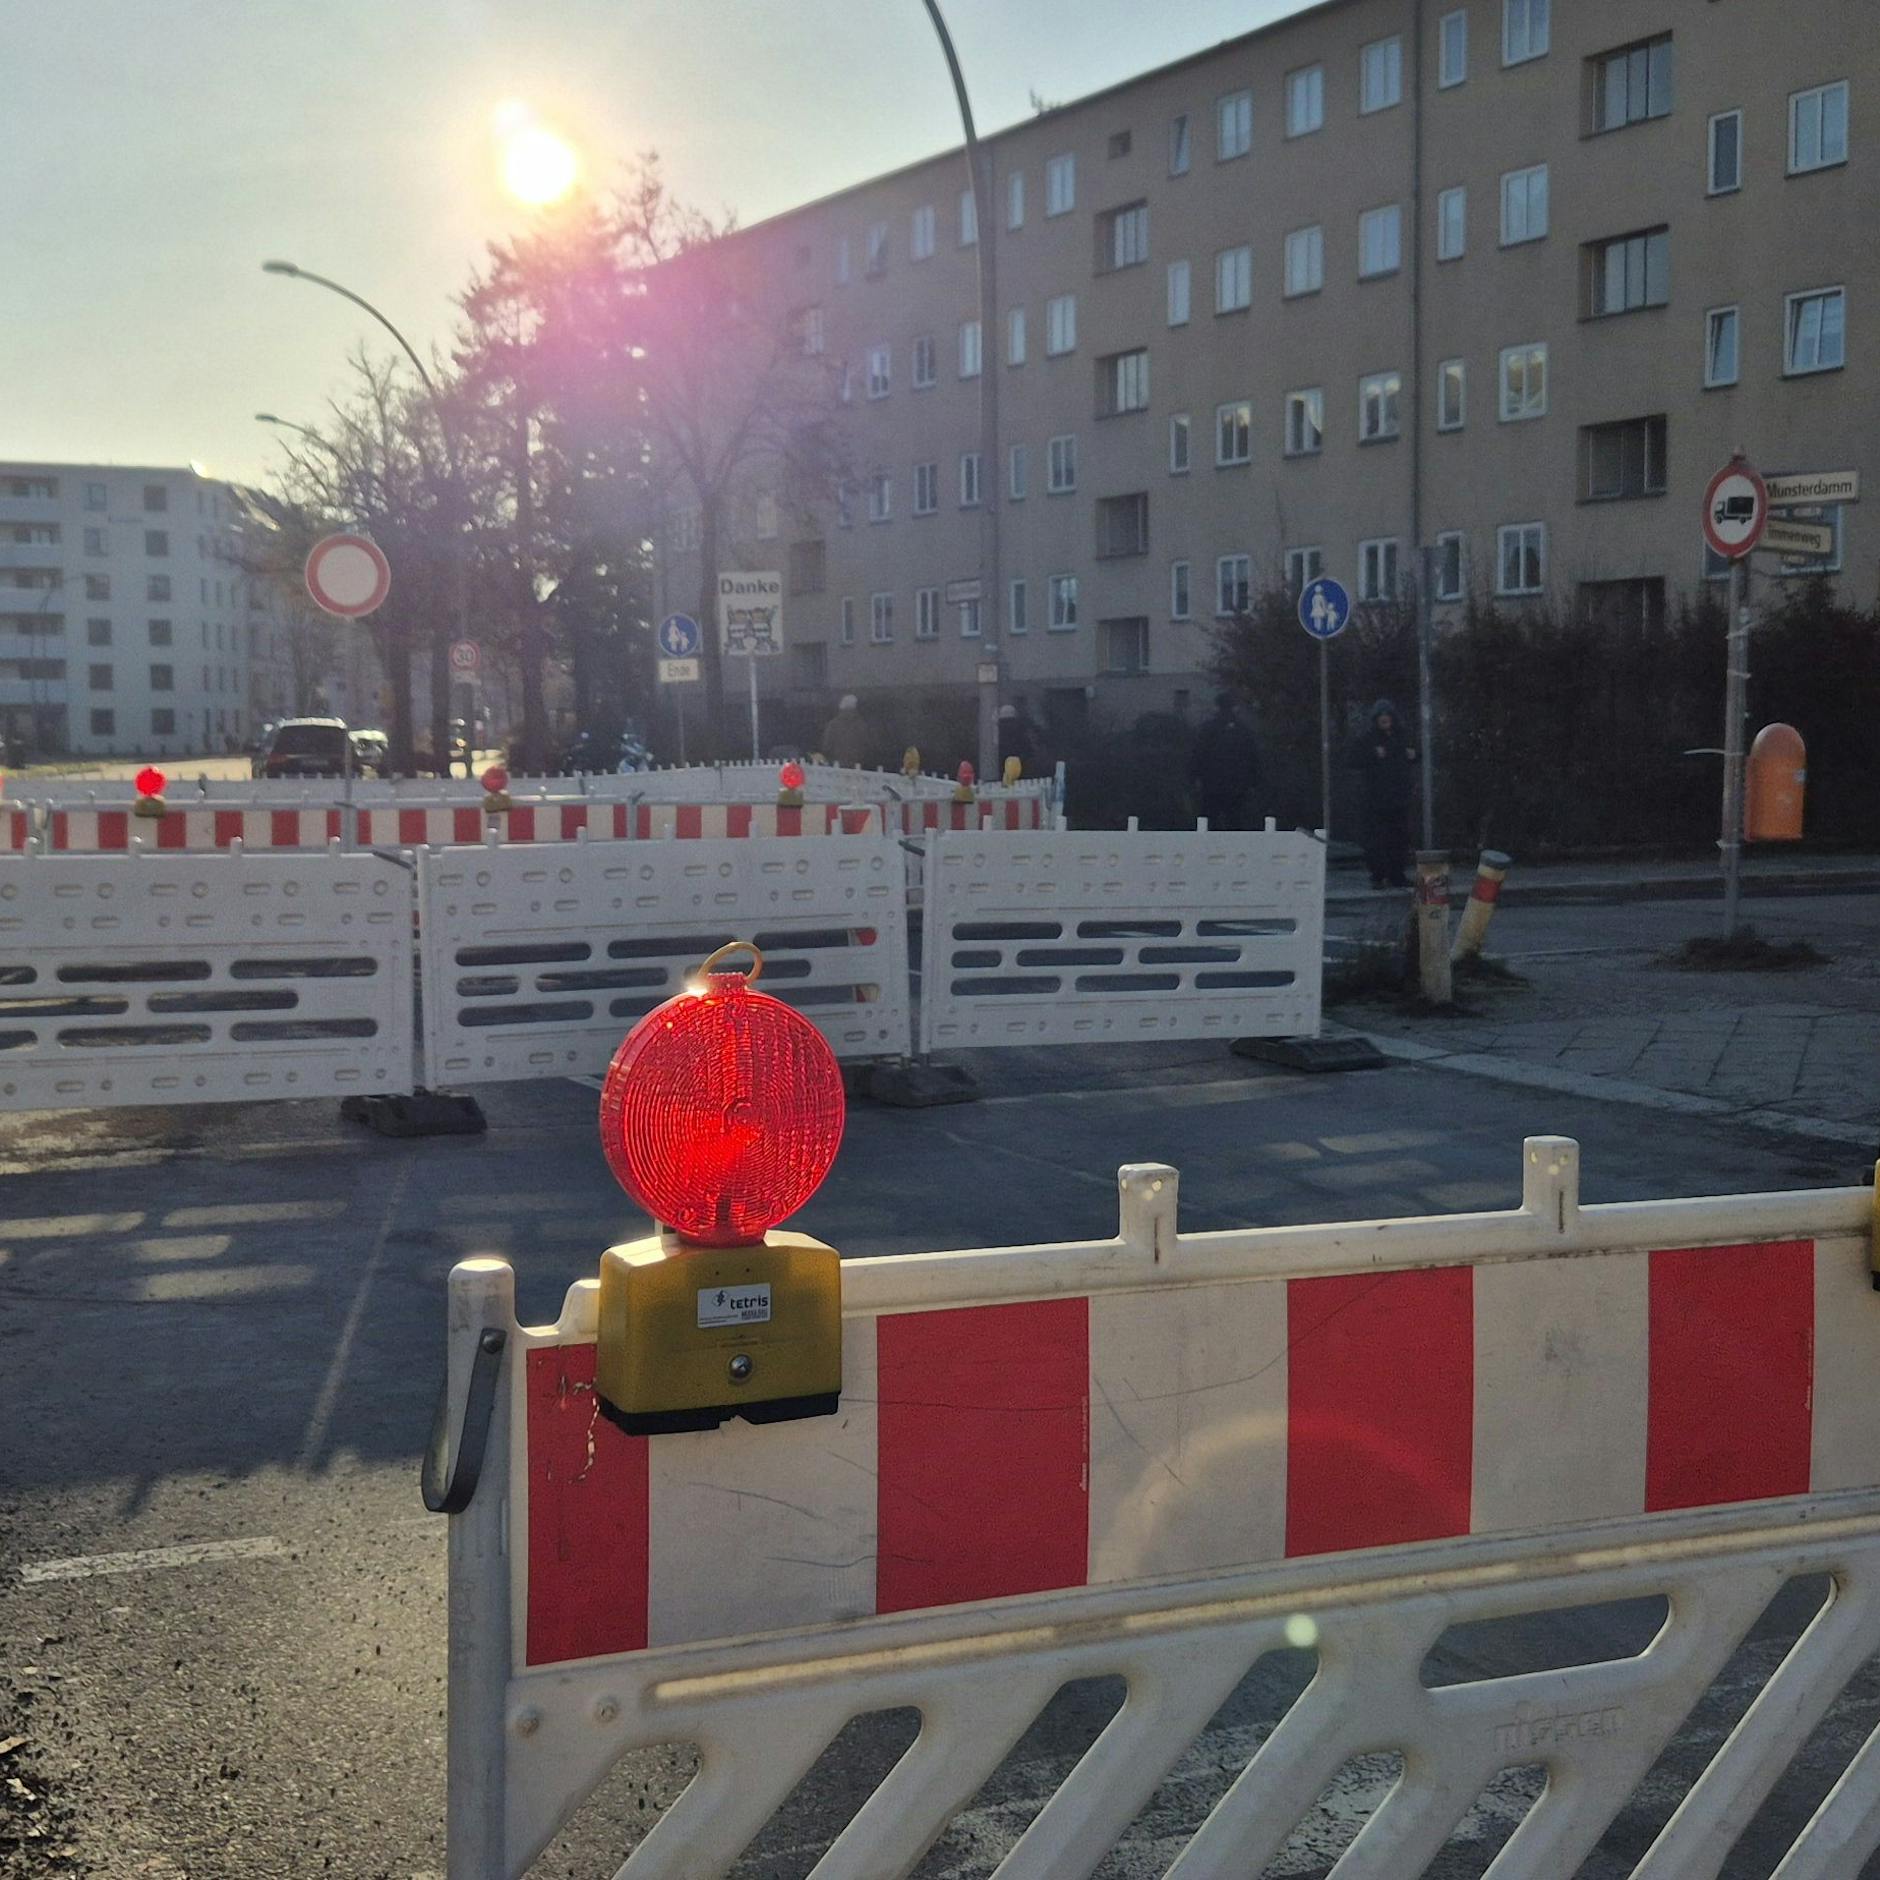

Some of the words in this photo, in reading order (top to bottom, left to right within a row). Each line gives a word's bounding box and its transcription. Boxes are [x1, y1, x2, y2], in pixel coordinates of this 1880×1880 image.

[1766, 479, 1852, 498] Munsterdamm
[720, 578, 780, 595] Danke
[456, 648, 474, 664] 30
[667, 662, 690, 677] Ende
[730, 1294, 769, 1310] tetris
